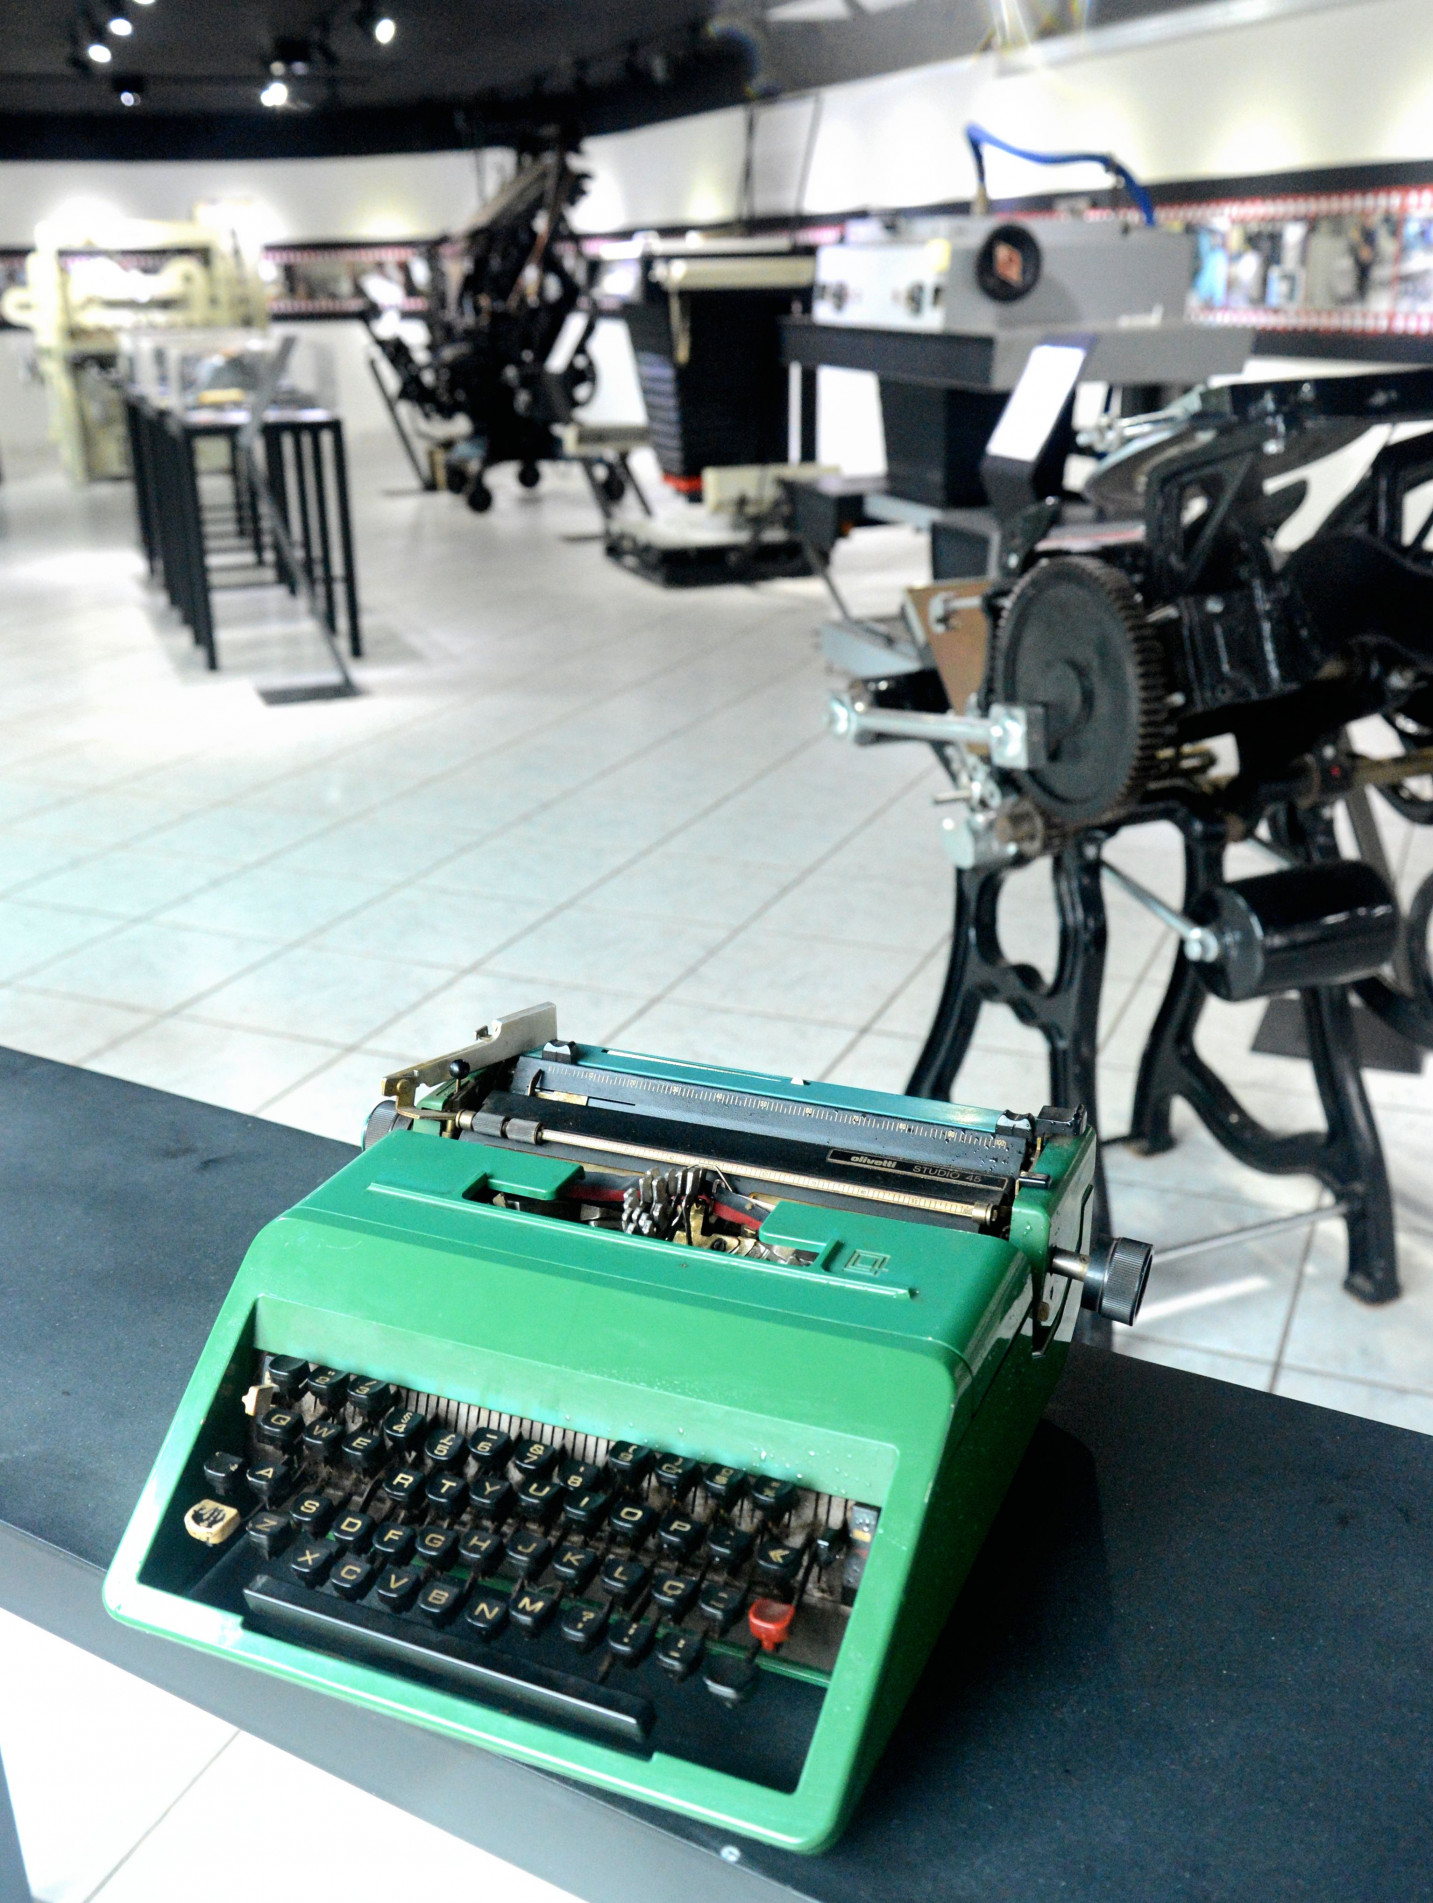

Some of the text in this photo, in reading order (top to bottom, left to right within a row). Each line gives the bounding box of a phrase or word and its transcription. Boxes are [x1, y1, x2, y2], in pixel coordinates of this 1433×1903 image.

[850, 1155, 982, 1183] olivetti STUDIO 45
[315, 1376, 330, 1386] 2
[355, 1386, 370, 1395] 3
[270, 1413, 291, 1426] Q
[313, 1425, 335, 1438] W
[392, 1424, 407, 1433] 4
[352, 1437, 372, 1449] E
[434, 1444, 450, 1456] 5
[476, 1441, 492, 1452] 6
[524, 1453, 538, 1463] 7
[255, 1467, 274, 1479] A
[393, 1473, 414, 1488] R
[441, 1479, 457, 1494] T
[567, 1475, 583, 1487] 8
[484, 1481, 501, 1495] Y
[528, 1483, 550, 1497] U
[300, 1500, 320, 1513] S
[579, 1496, 590, 1508] I
[620, 1507, 644, 1521] O
[255, 1518, 278, 1532] Z
[340, 1517, 362, 1533] D
[669, 1520, 692, 1532] P
[383, 1529, 404, 1542] F
[424, 1533, 446, 1548] G
[469, 1535, 491, 1551] H
[517, 1542, 537, 1553] J
[297, 1550, 321, 1566] X
[563, 1552, 585, 1567] K
[340, 1565, 361, 1580] C
[613, 1566, 628, 1581] L
[390, 1574, 409, 1589] V
[428, 1589, 449, 1605] B
[474, 1602, 499, 1620] N
[517, 1596, 545, 1614] M
